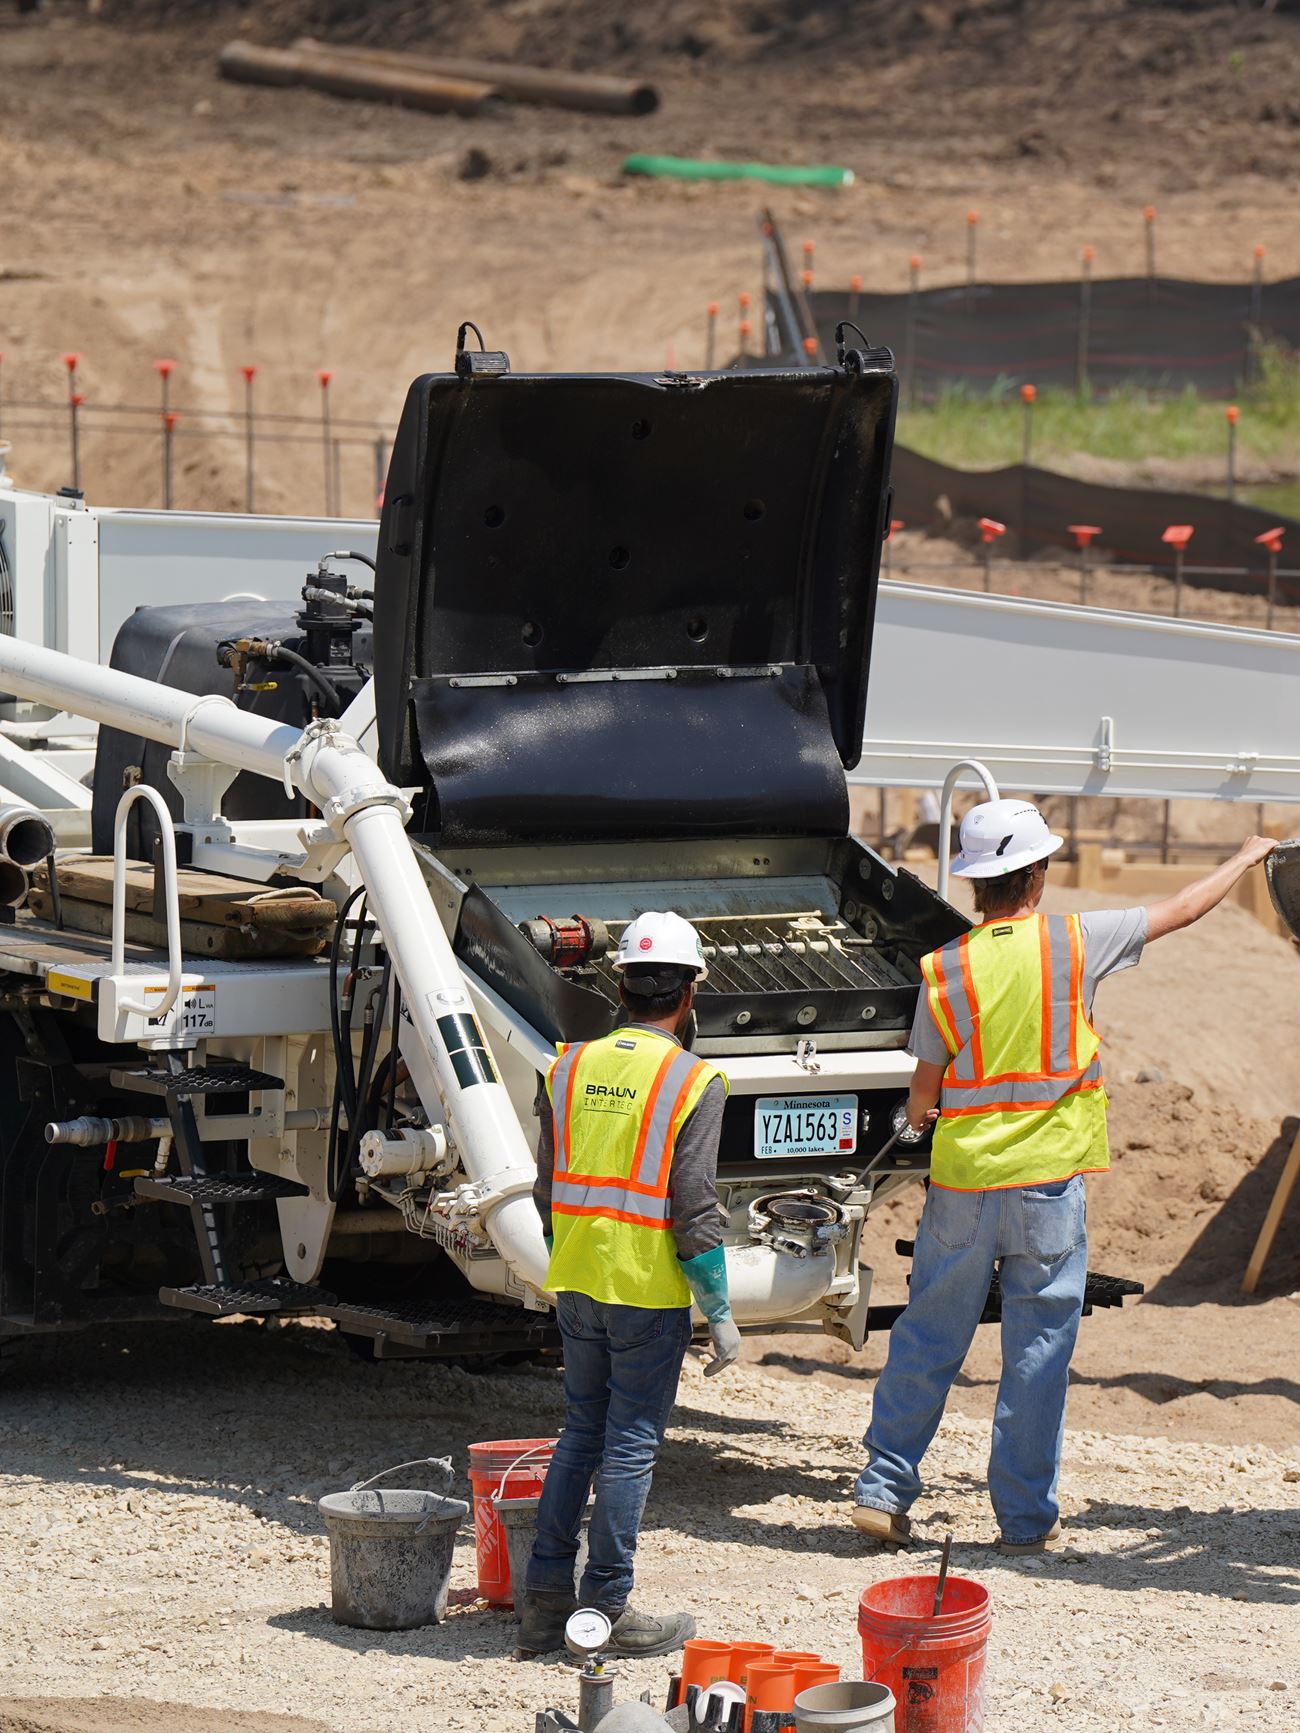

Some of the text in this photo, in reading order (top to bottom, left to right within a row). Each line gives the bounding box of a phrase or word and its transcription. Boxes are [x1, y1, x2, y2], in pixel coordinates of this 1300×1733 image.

[585, 1084, 637, 1099] BRAUN
[783, 1100, 831, 1110] Minnesota
[842, 1112, 852, 1125] S
[762, 1112, 838, 1144] YZA1563
[761, 1146, 773, 1154] FEB
